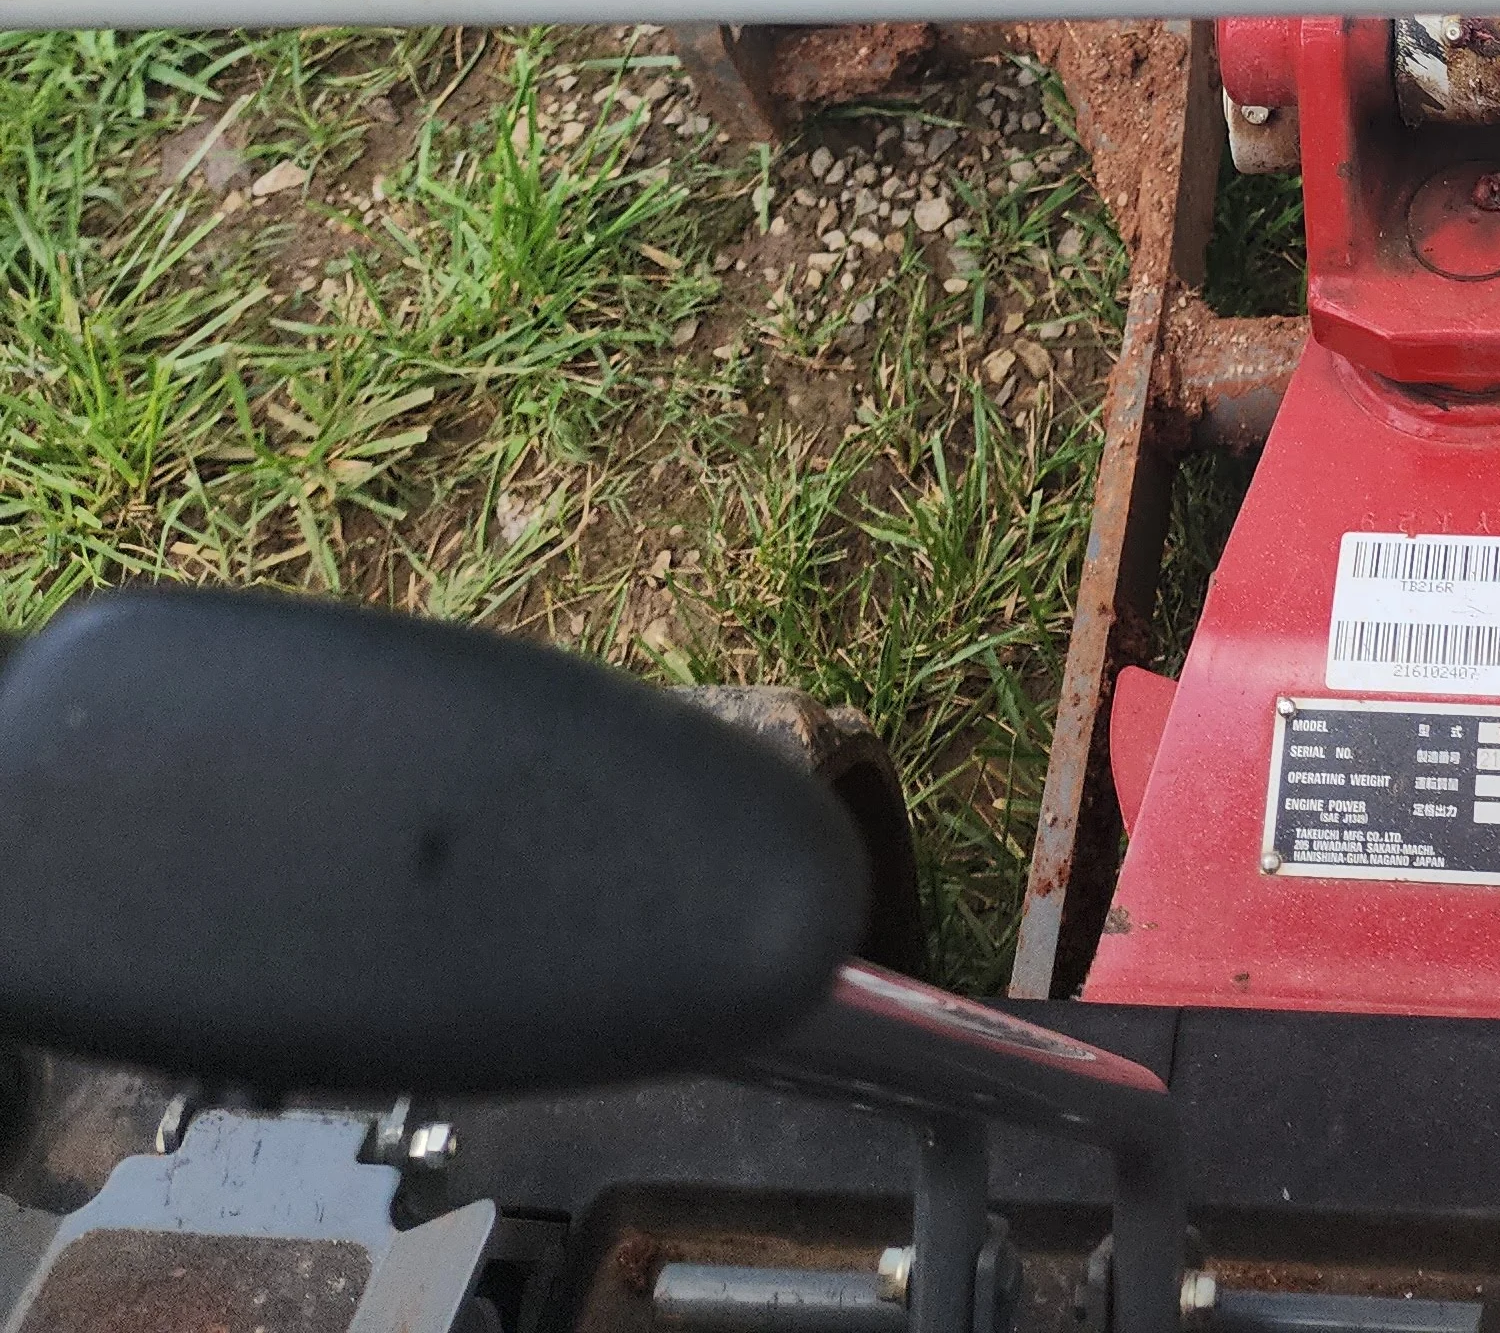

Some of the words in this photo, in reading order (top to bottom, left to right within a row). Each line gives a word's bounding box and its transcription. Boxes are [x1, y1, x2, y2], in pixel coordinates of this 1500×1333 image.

[1400, 580, 1454, 593] TB216R
[1393, 664, 1478, 680] 216102407
[1292, 719, 1329, 733] MODEL
[1289, 745, 1326, 759] SERIAL
[1335, 746, 1354, 759] NO.
[1287, 770, 1346, 785] OPERATING
[1350, 773, 1392, 788] WEIGHT
[1284, 797, 1324, 812] ENGINE
[1328, 799, 1366, 813] POWER
[1319, 812, 1341, 824] (SAE
[1296, 828, 1340, 841] TAKEUCHI
[1412, 856, 1446, 868] JAPAN
